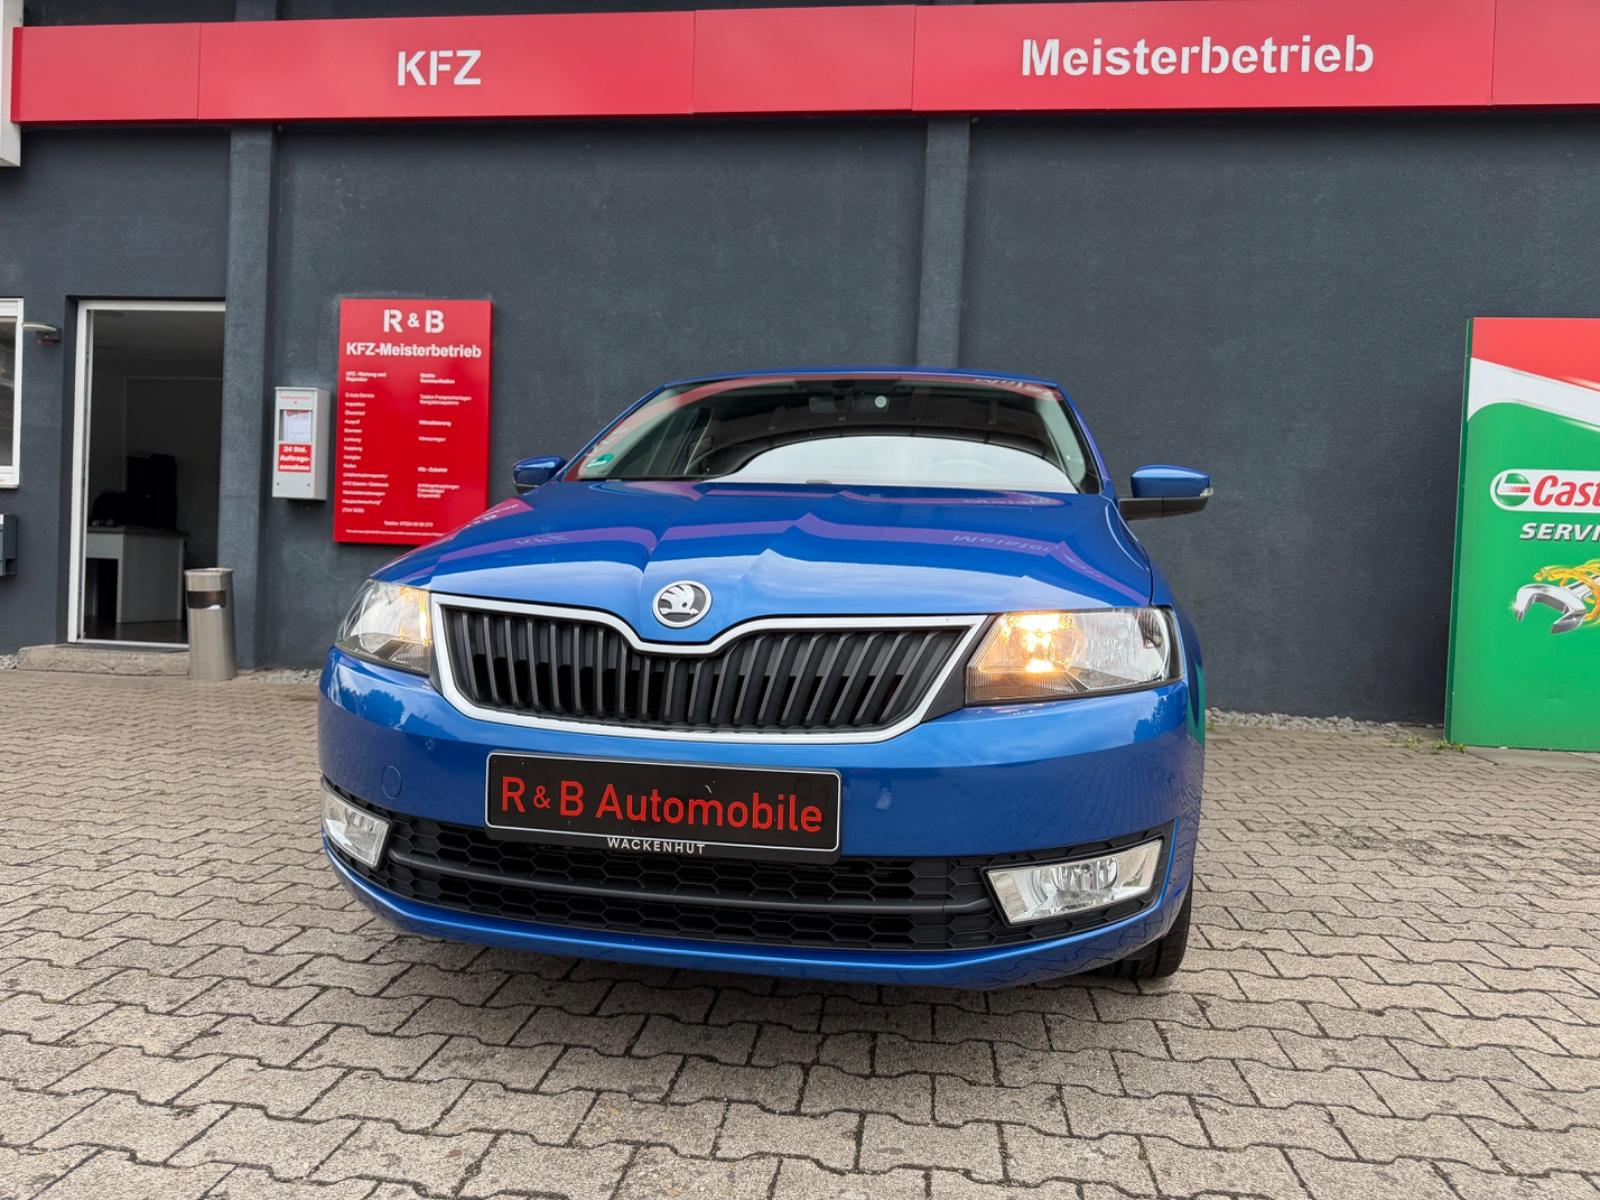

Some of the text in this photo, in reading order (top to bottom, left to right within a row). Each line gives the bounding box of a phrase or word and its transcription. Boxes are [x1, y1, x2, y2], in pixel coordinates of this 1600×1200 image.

[397, 49, 482, 87] KFZ
[1021, 34, 1375, 77] Meisterbetrieb
[383, 309, 445, 333] R & B
[346, 342, 482, 358] KFZ-Meisterbetrieb
[1533, 474, 1600, 508] Cast
[501, 776, 823, 833] R & B Automobile
[607, 837, 705, 855] WACKENHUT
